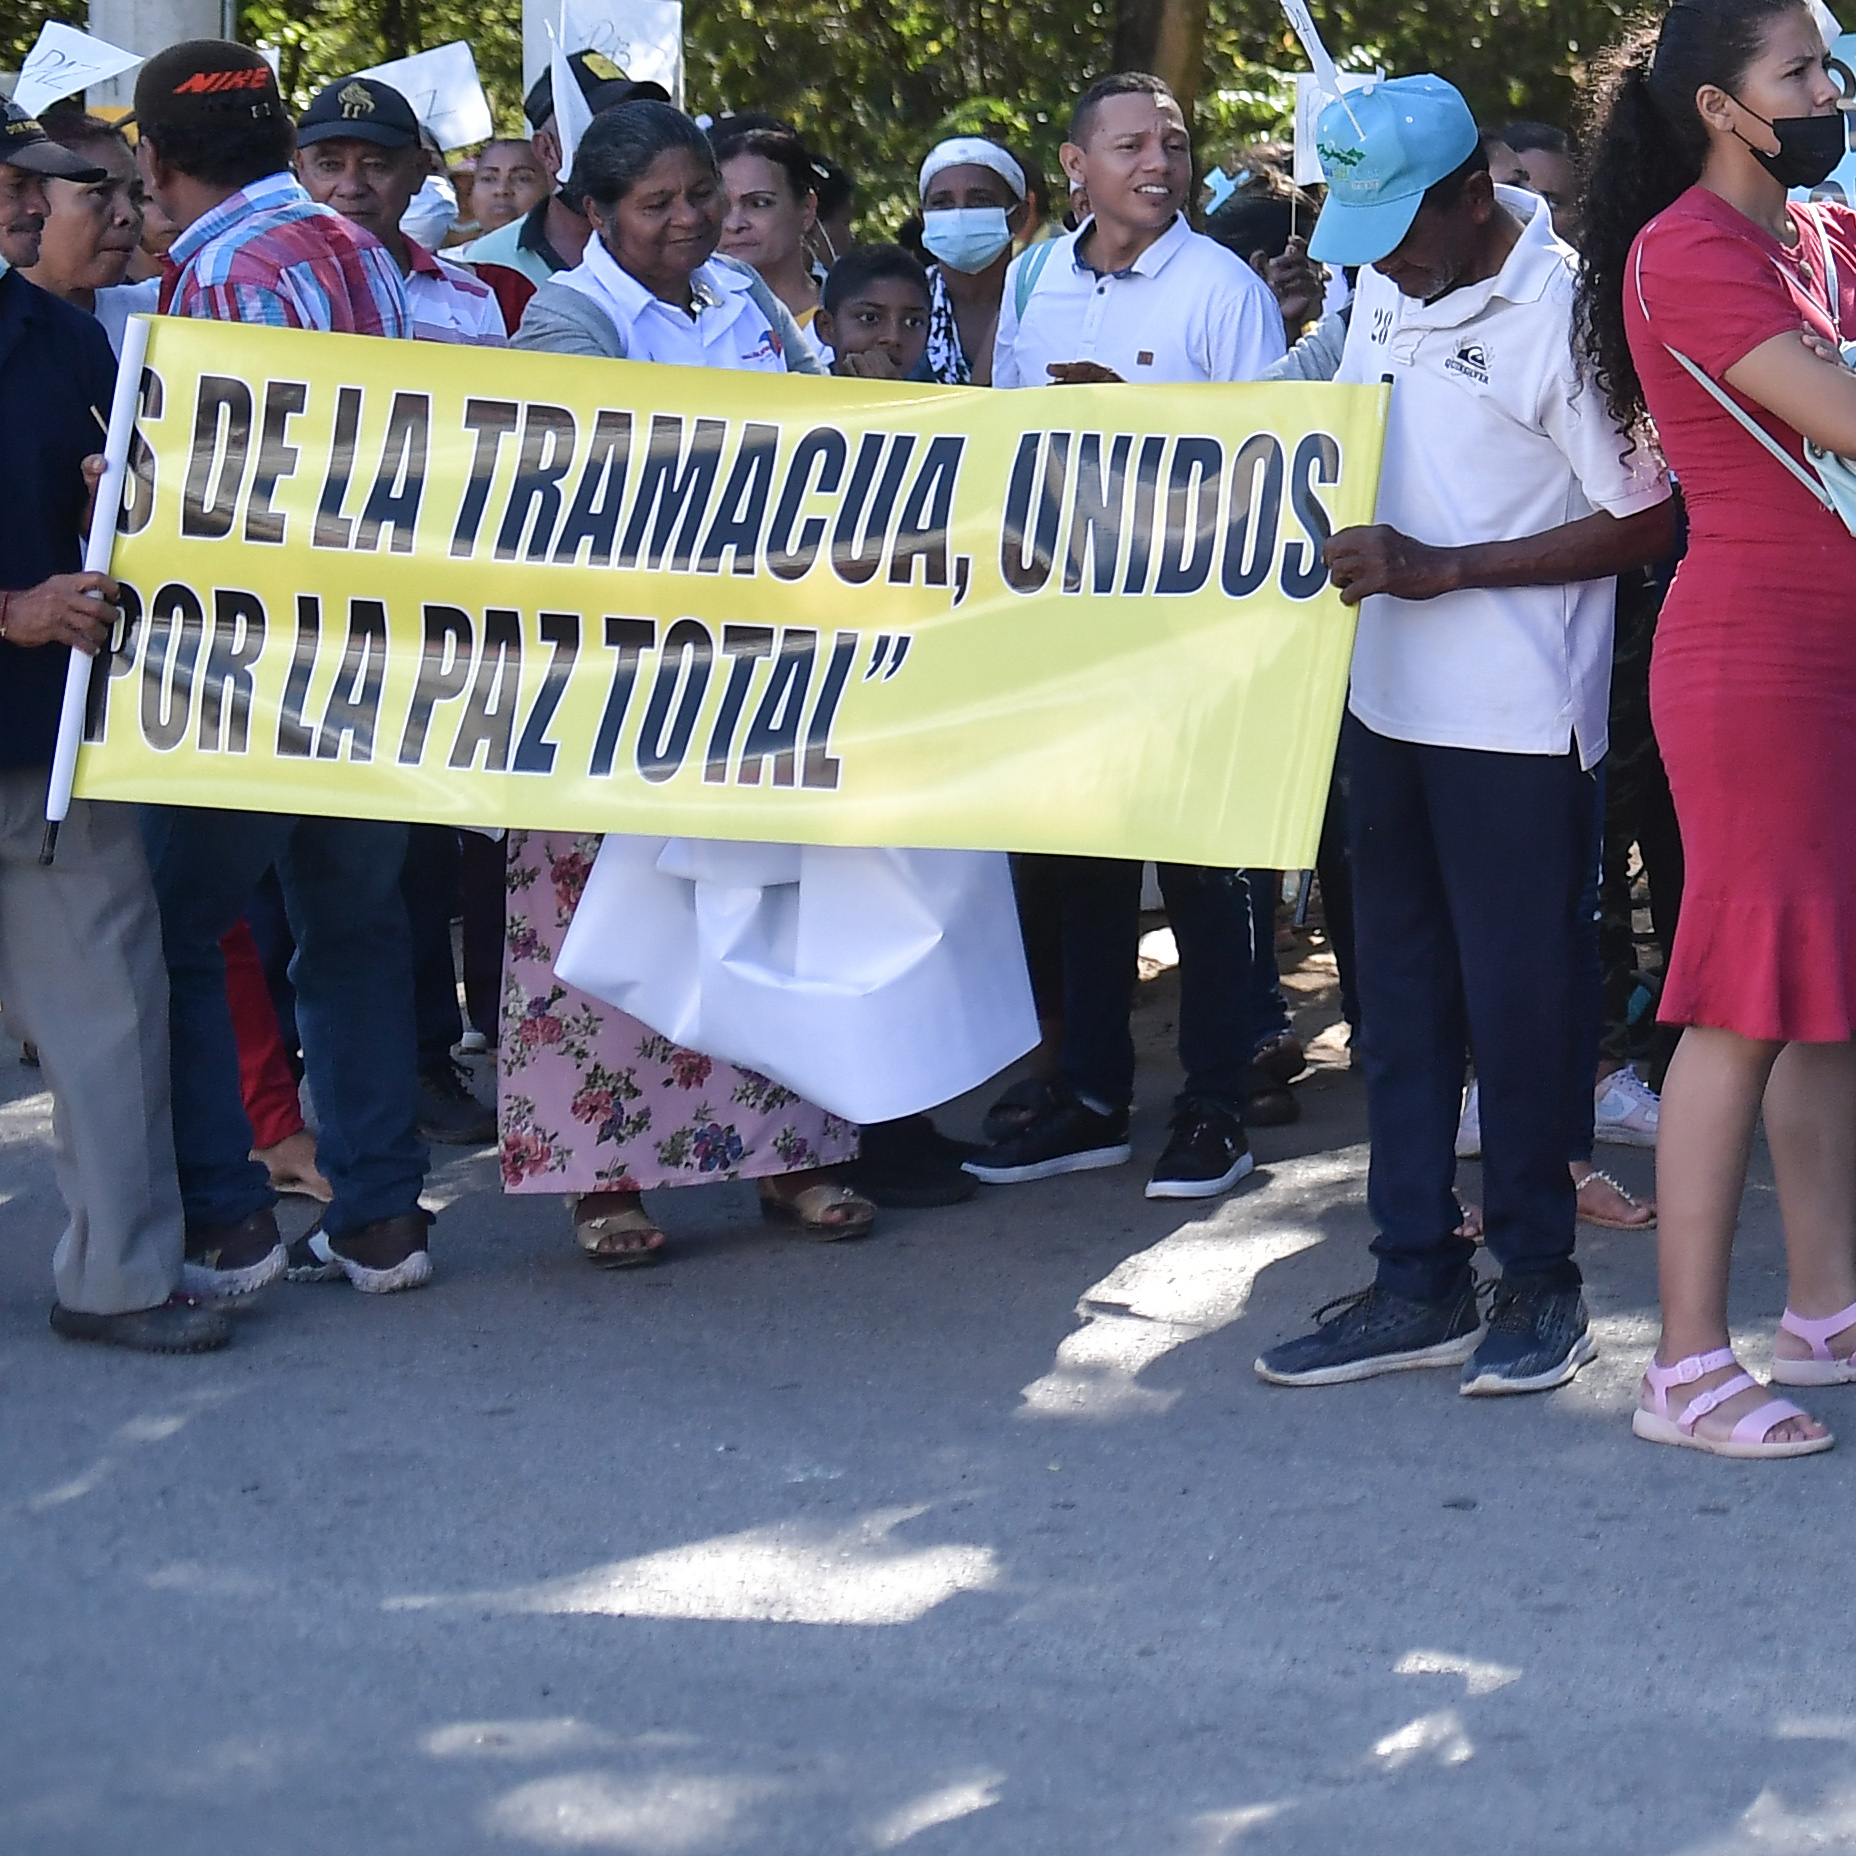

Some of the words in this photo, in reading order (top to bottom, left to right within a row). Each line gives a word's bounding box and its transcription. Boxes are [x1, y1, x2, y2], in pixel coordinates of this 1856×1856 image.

[1369, 307, 1394, 346] 28
[178, 373, 310, 546] DE
[311, 384, 433, 558] LA
[446, 396, 974, 608] TRAMACUA,
[1000, 429, 1344, 603] UNIDOS
[274, 592, 390, 764] LA
[397, 602, 581, 777] PAZ
